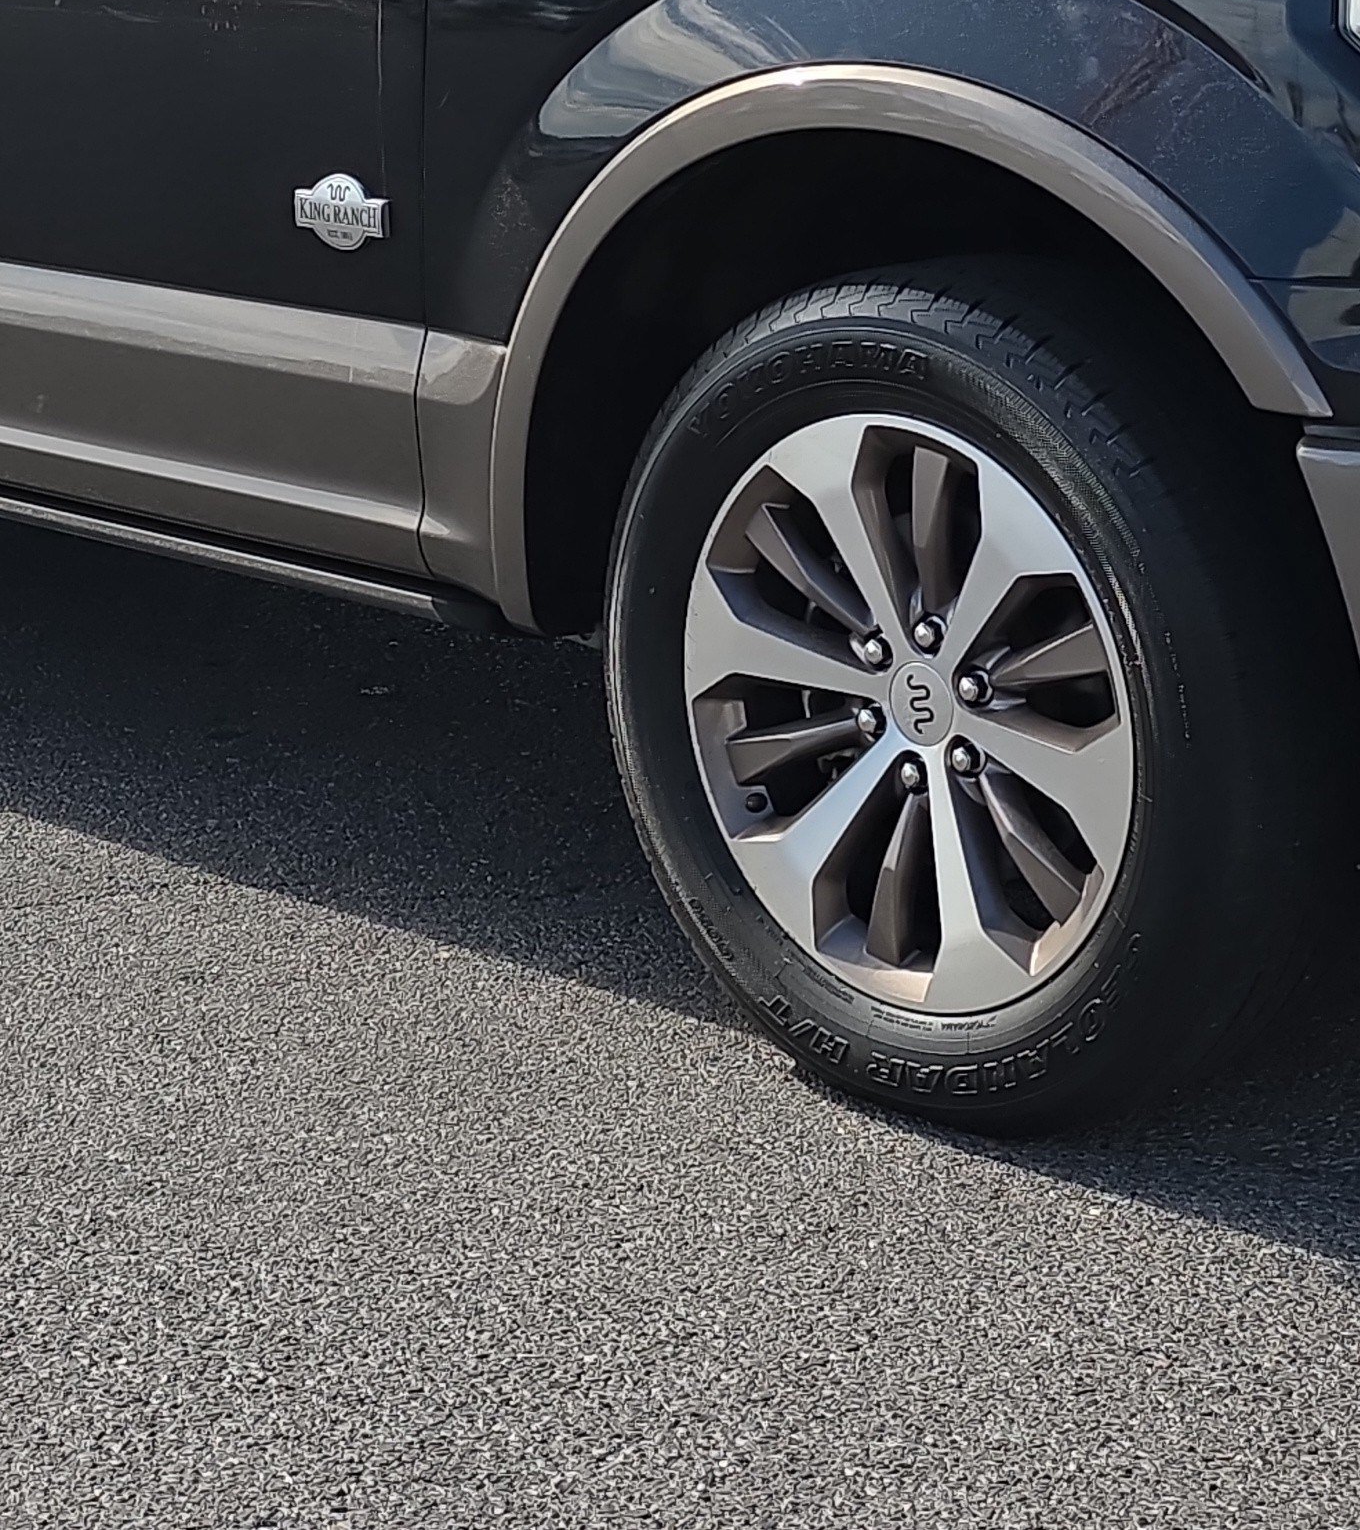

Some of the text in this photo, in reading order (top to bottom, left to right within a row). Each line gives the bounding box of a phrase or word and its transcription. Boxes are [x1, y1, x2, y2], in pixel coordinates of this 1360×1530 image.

[299, 197, 377, 229] KING RANCH
[687, 340, 929, 438] YOKOHAMA
